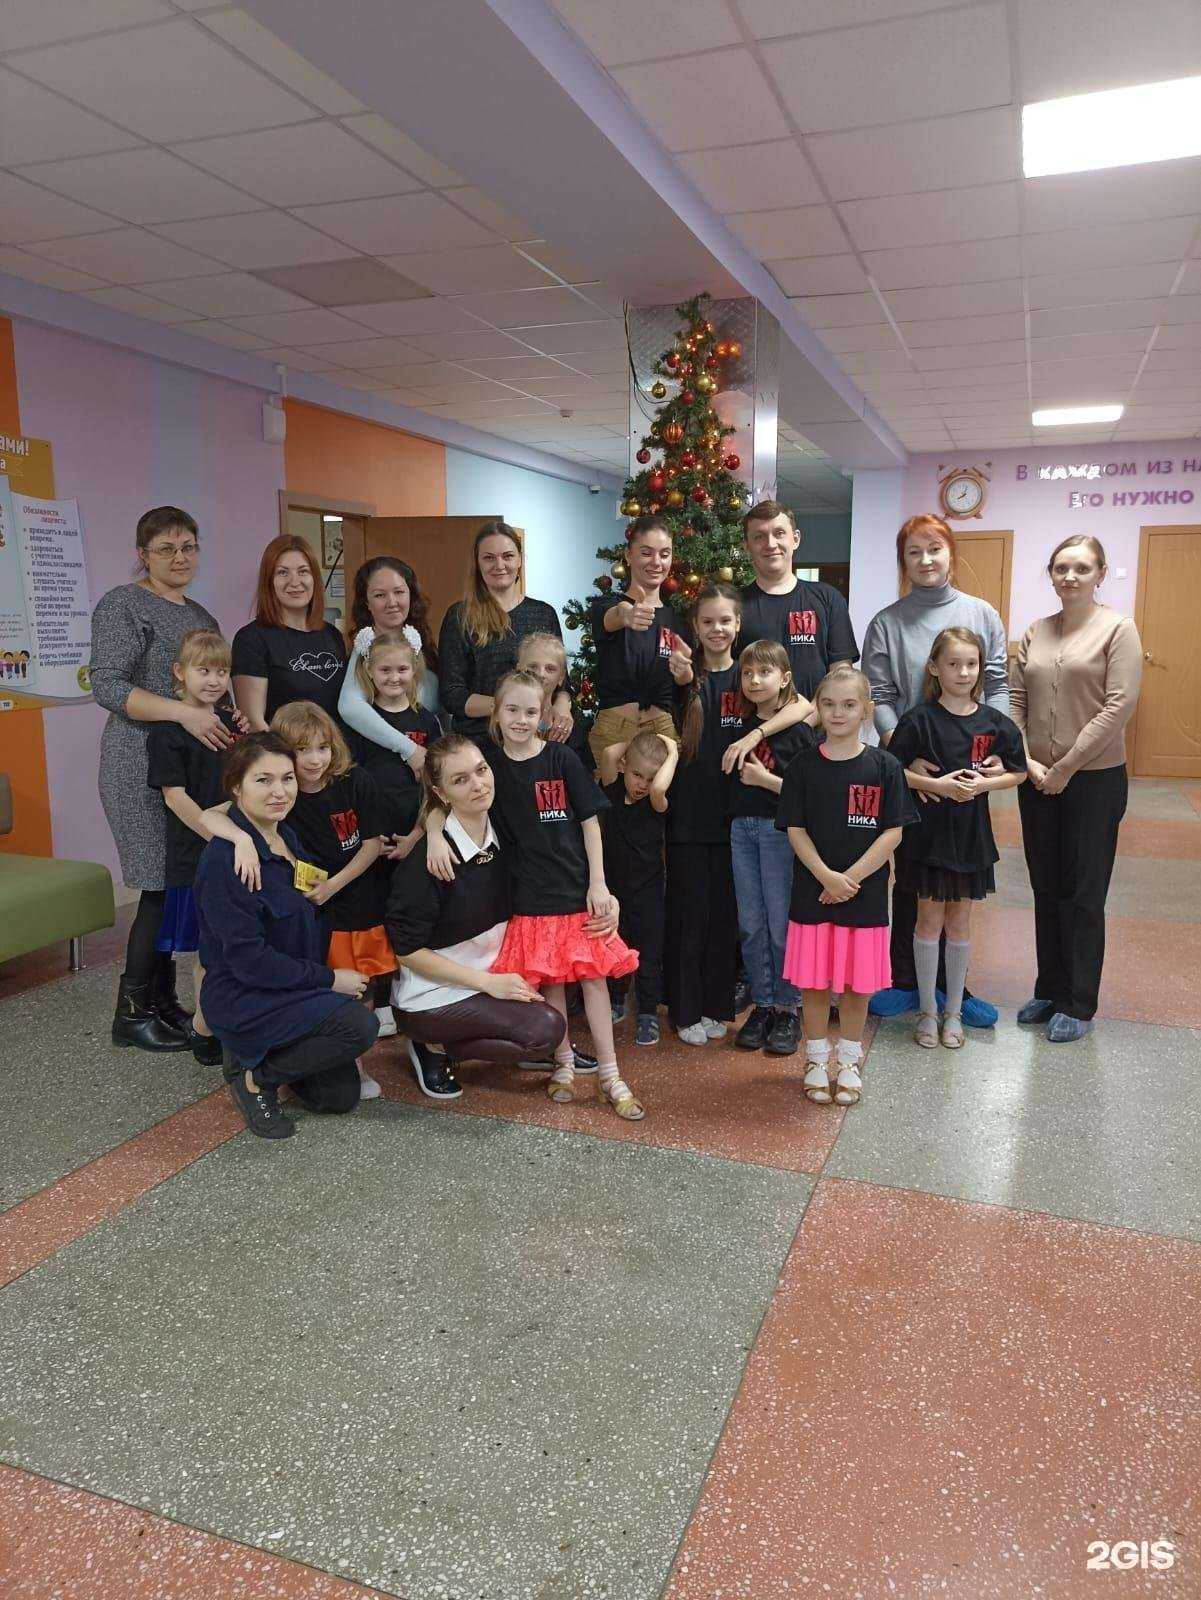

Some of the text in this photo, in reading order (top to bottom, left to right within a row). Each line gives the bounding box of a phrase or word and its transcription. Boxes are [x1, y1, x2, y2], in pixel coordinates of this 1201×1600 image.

[1016, 464, 1028, 481] В
[1147, 460, 1172, 475] ИЗ
[1112, 489, 1194, 507] НУЖНО
[790, 634, 815, 642] НИКА
[721, 716, 743, 725] НИКА
[540, 810, 567, 820] НИКА
[848, 814, 877, 825] НИКА
